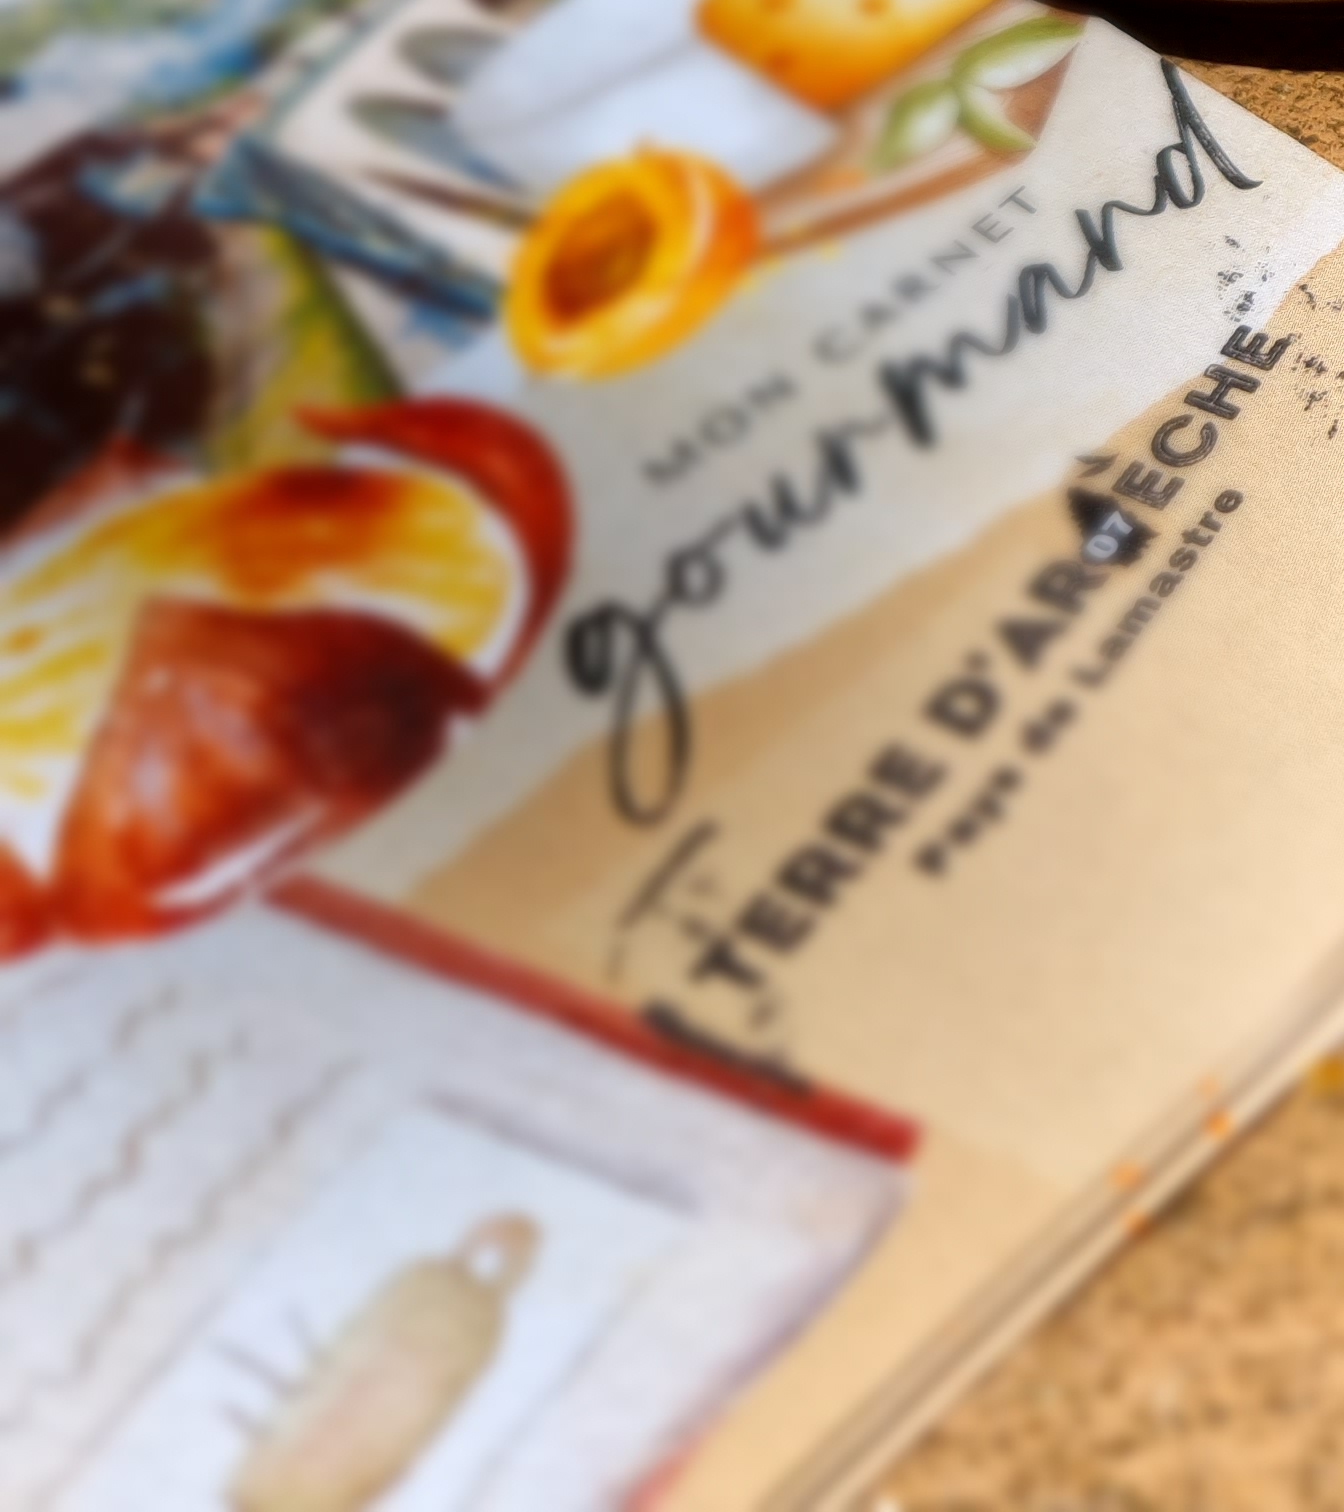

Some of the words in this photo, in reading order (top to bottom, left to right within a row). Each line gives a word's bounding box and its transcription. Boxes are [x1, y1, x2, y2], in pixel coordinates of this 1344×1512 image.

[560, 56, 1262, 828] gourmand
[643, 375, 796, 490] MON
[812, 183, 1038, 363] CARNET
[910, 758, 1025, 880] Pays
[1020, 696, 1077, 754] de
[1068, 486, 1245, 690] Lamastre
[1083, 510, 1134, 561] 07
[689, 742, 943, 988] TERRE
